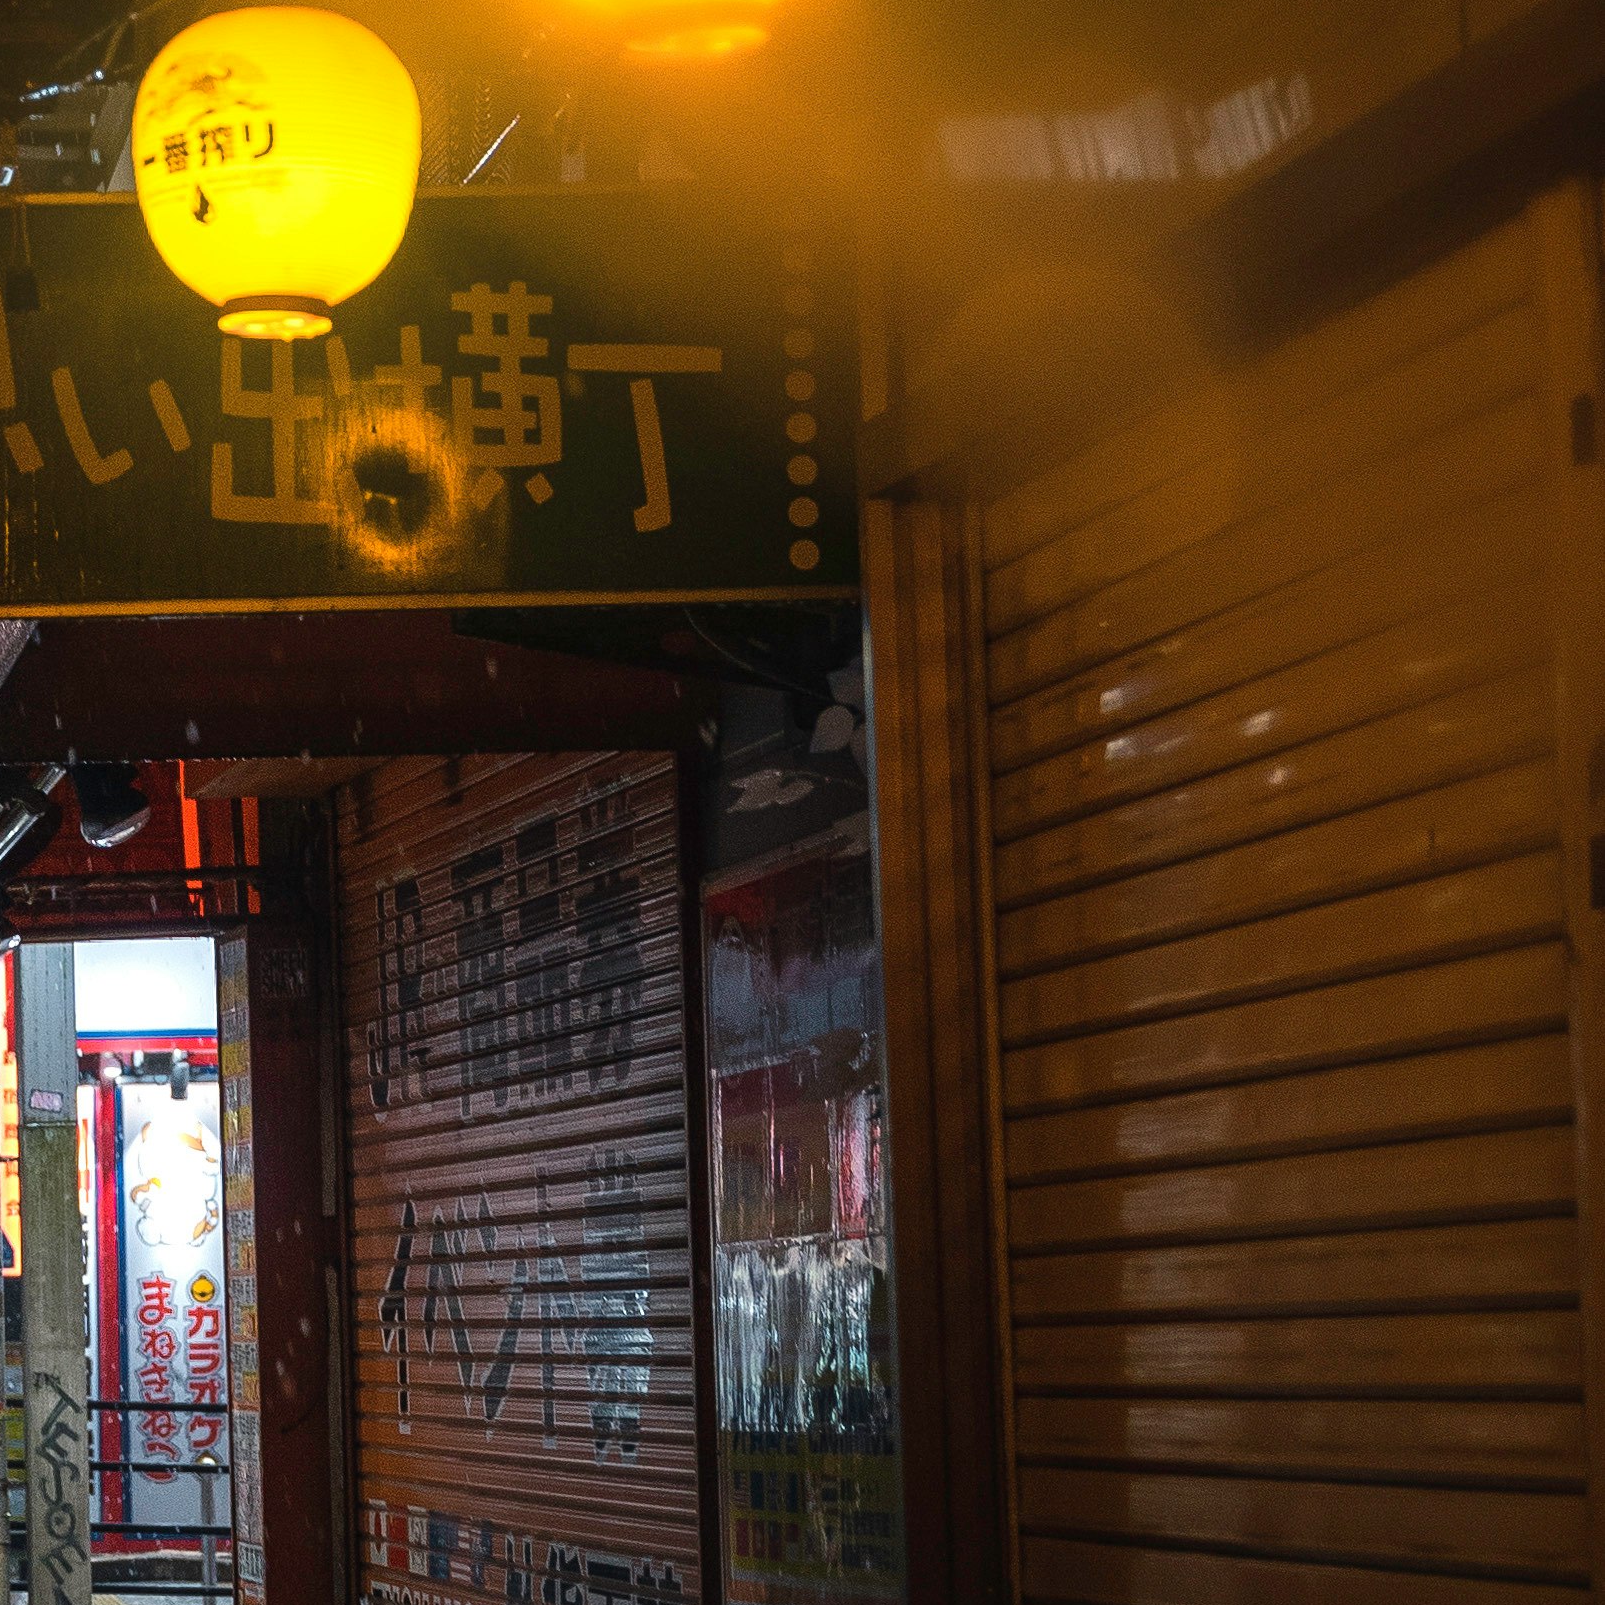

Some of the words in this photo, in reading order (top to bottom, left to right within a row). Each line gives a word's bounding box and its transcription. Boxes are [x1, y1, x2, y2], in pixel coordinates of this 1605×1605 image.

[143, 121, 275, 175] 一番搾り
[187, 1305, 223, 1449] カラオケ
